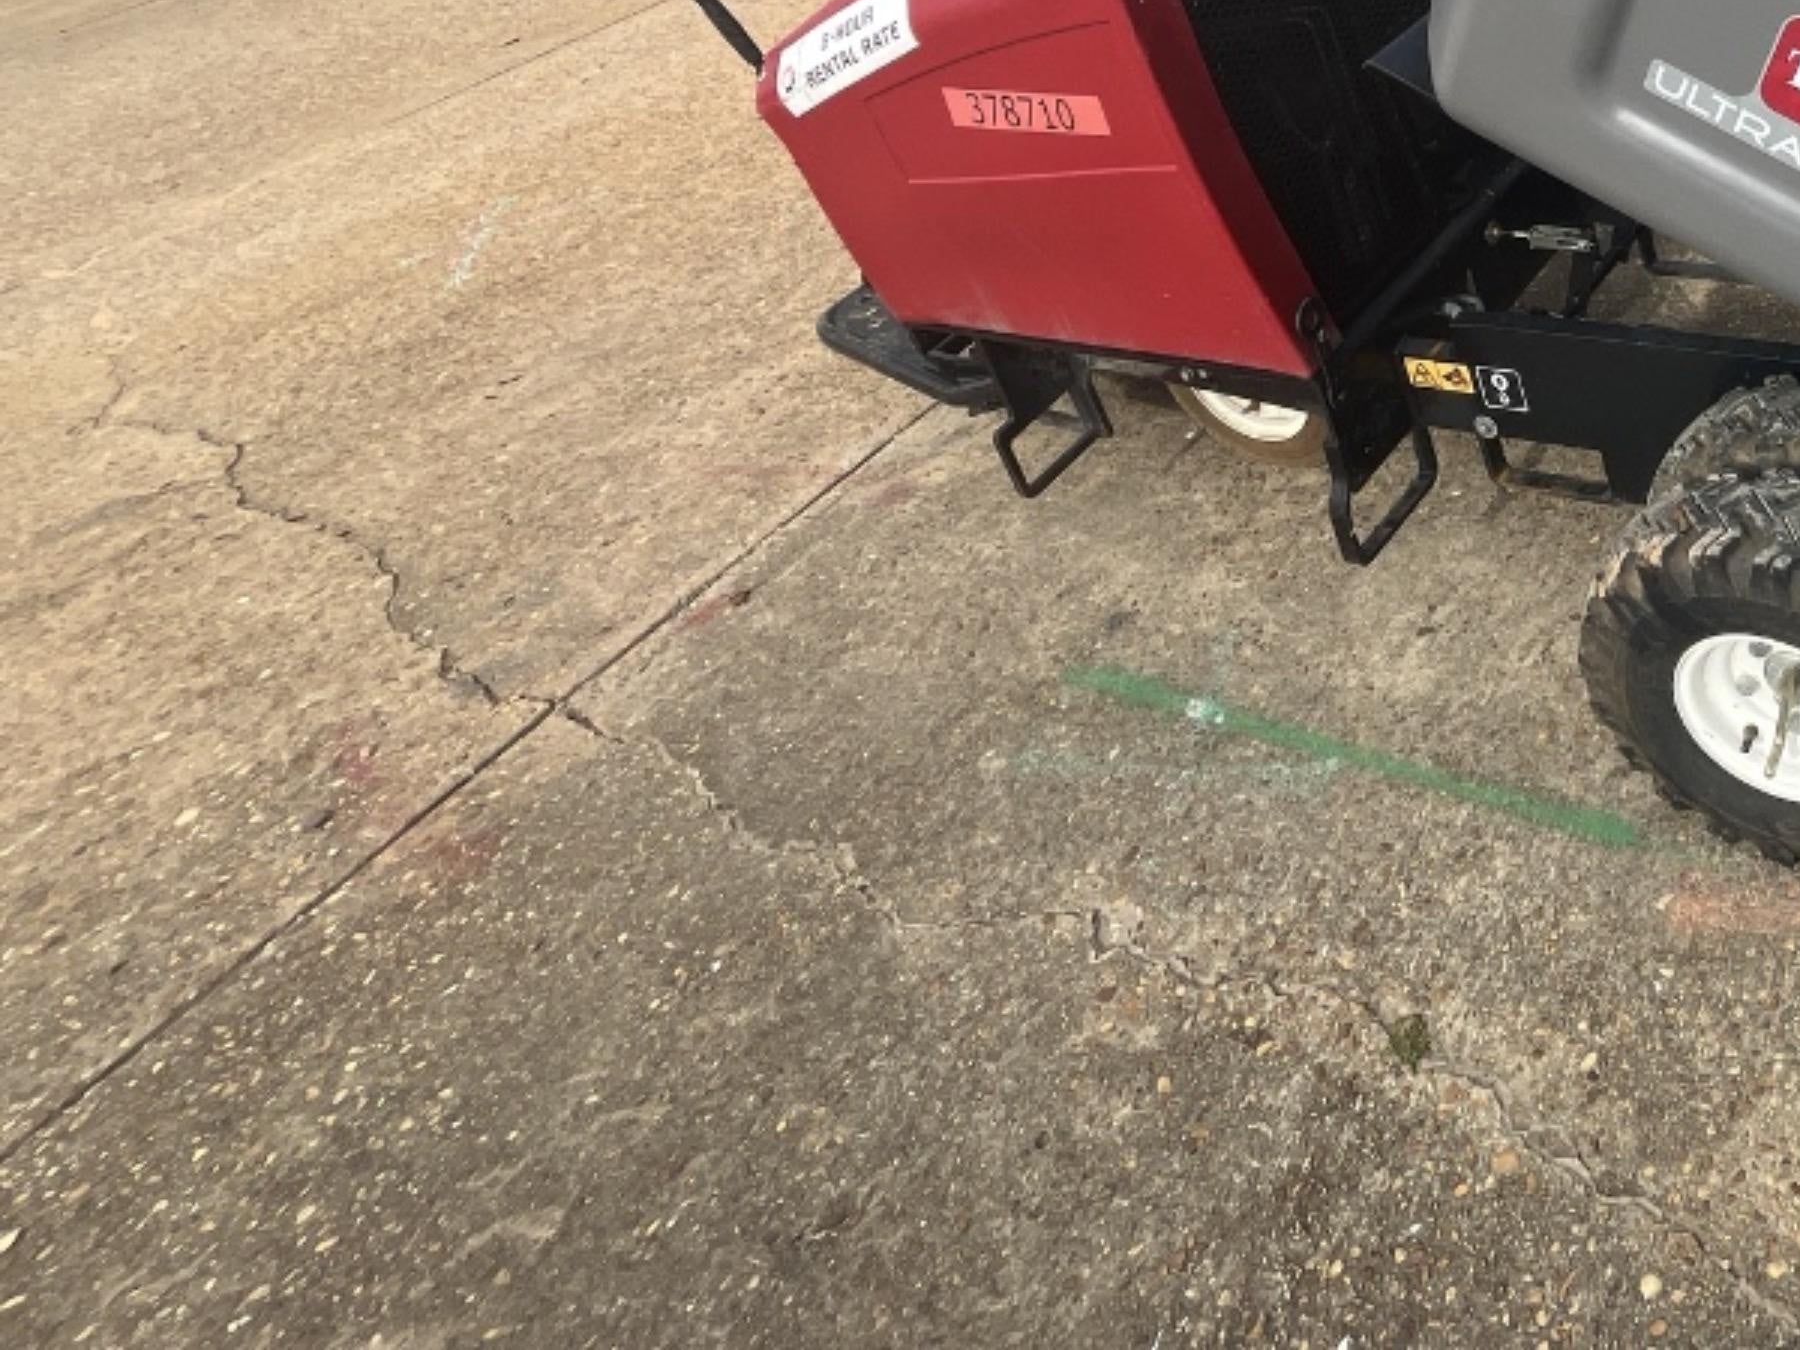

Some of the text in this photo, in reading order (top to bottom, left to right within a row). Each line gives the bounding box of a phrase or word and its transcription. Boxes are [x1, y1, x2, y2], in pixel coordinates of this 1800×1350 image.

[804, 19, 901, 89] RENTAL RATE
[964, 92, 1076, 131] 378710
